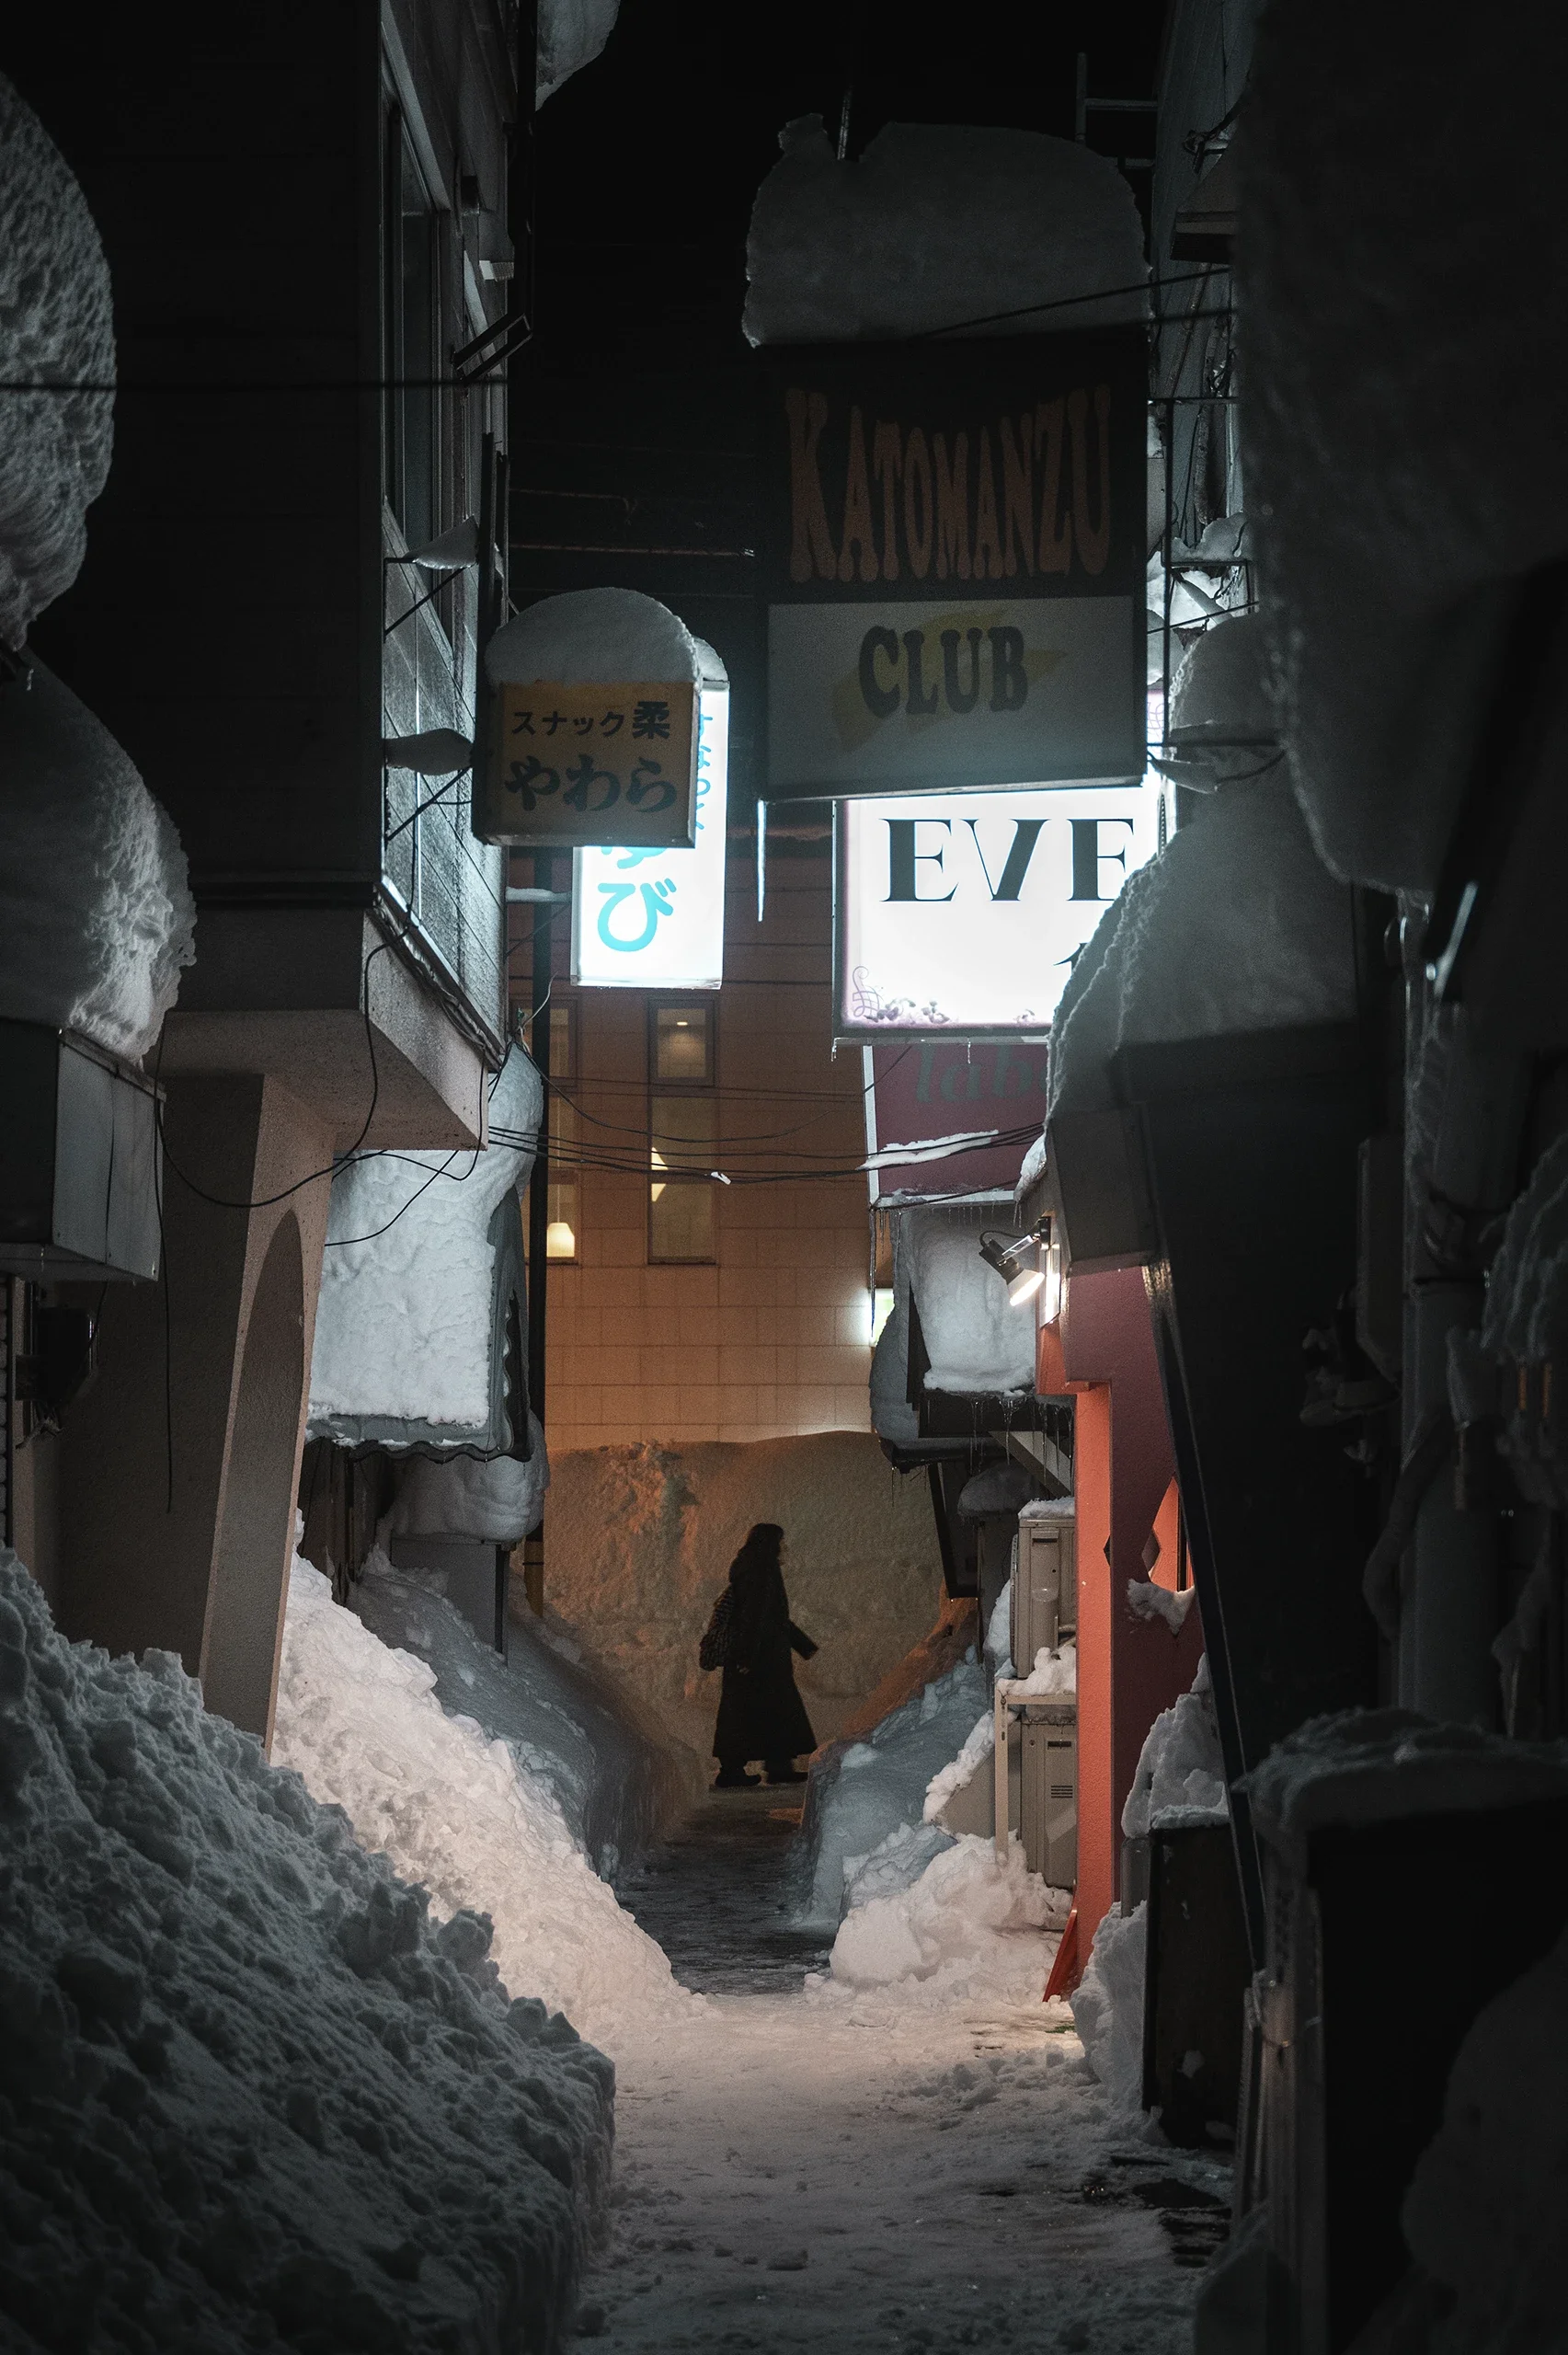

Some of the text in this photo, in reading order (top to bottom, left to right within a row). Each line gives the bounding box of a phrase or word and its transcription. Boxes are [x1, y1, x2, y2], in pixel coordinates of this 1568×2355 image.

[784, 384, 1111, 583] KATOMANZU
[859, 626, 1028, 719] CLUB
[512, 701, 670, 740] スナック柔
[504, 753, 679, 813] やわら
[879, 818, 1135, 902] EVE
